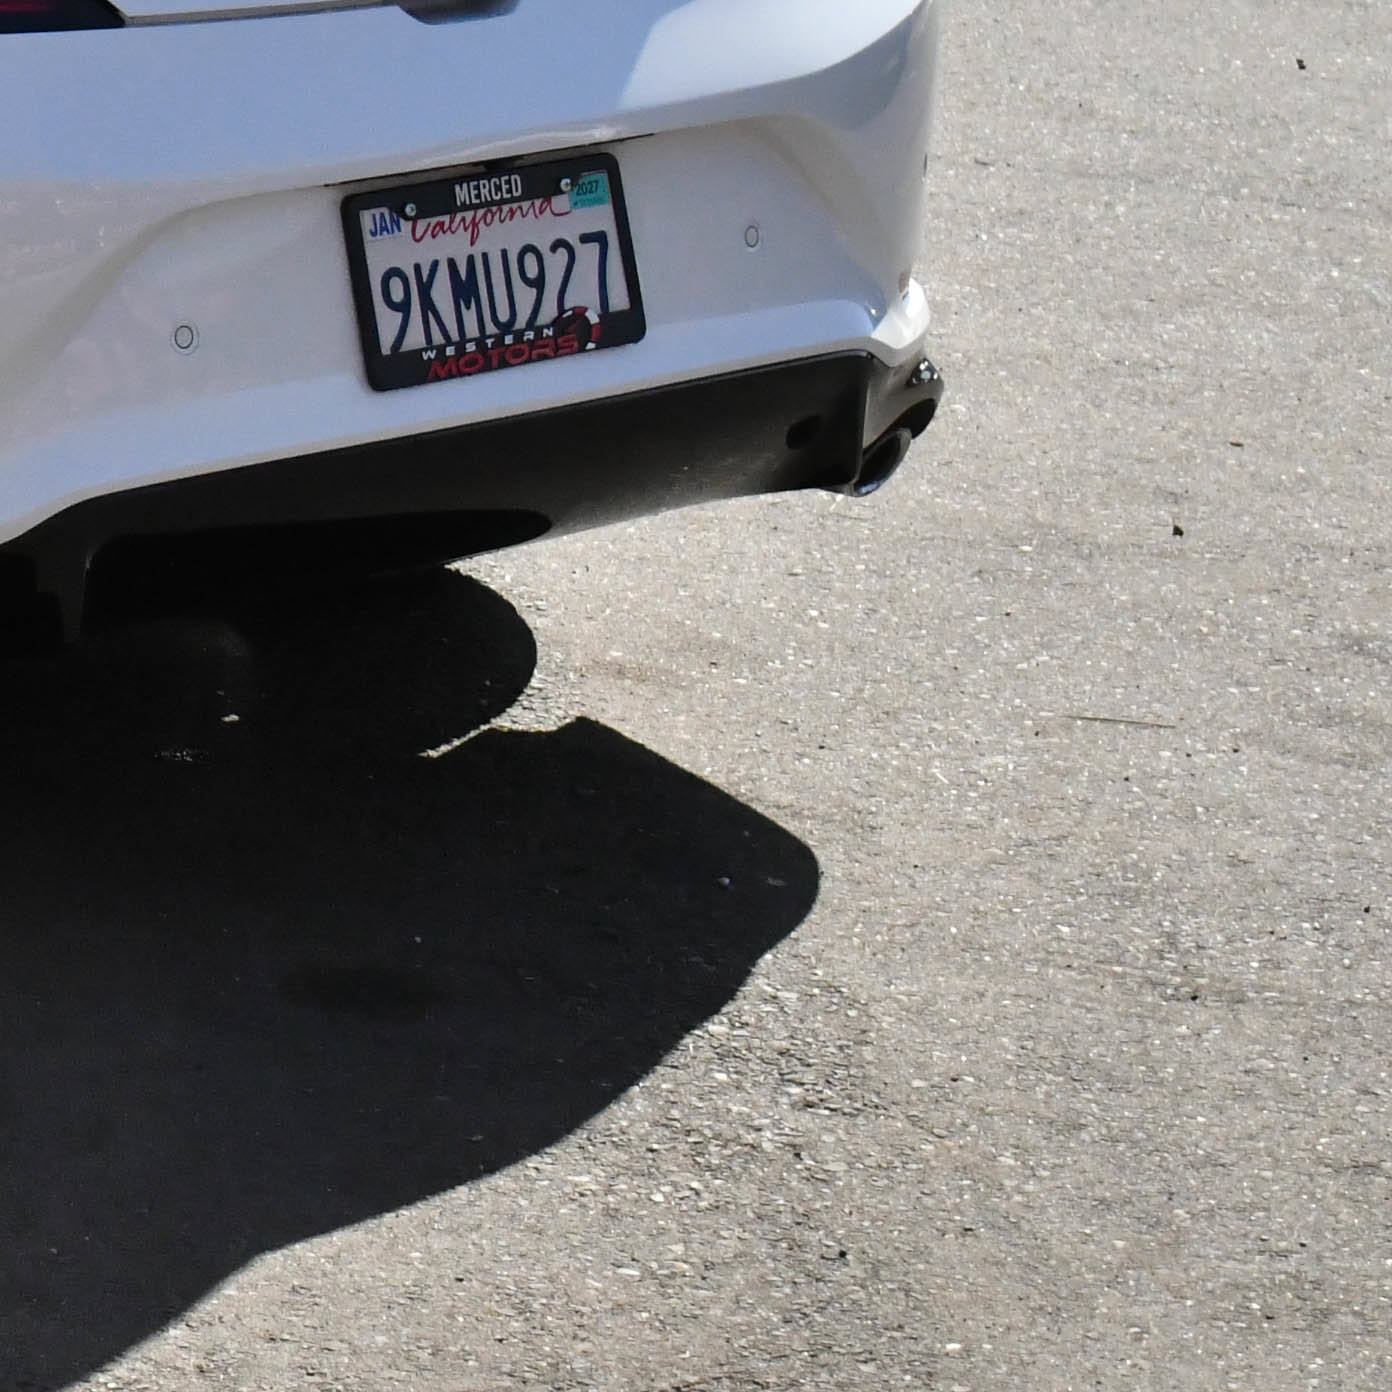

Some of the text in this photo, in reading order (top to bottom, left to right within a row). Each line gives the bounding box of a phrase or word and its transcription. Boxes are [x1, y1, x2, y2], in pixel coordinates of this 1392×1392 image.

[455, 174, 522, 207] MERCED
[575, 179, 599, 196] 2027
[369, 212, 401, 238] JAN
[411, 196, 572, 247] California
[381, 230, 609, 354] 9KMU927
[422, 327, 554, 360] WESTERN
[429, 334, 579, 380] MOTORS
